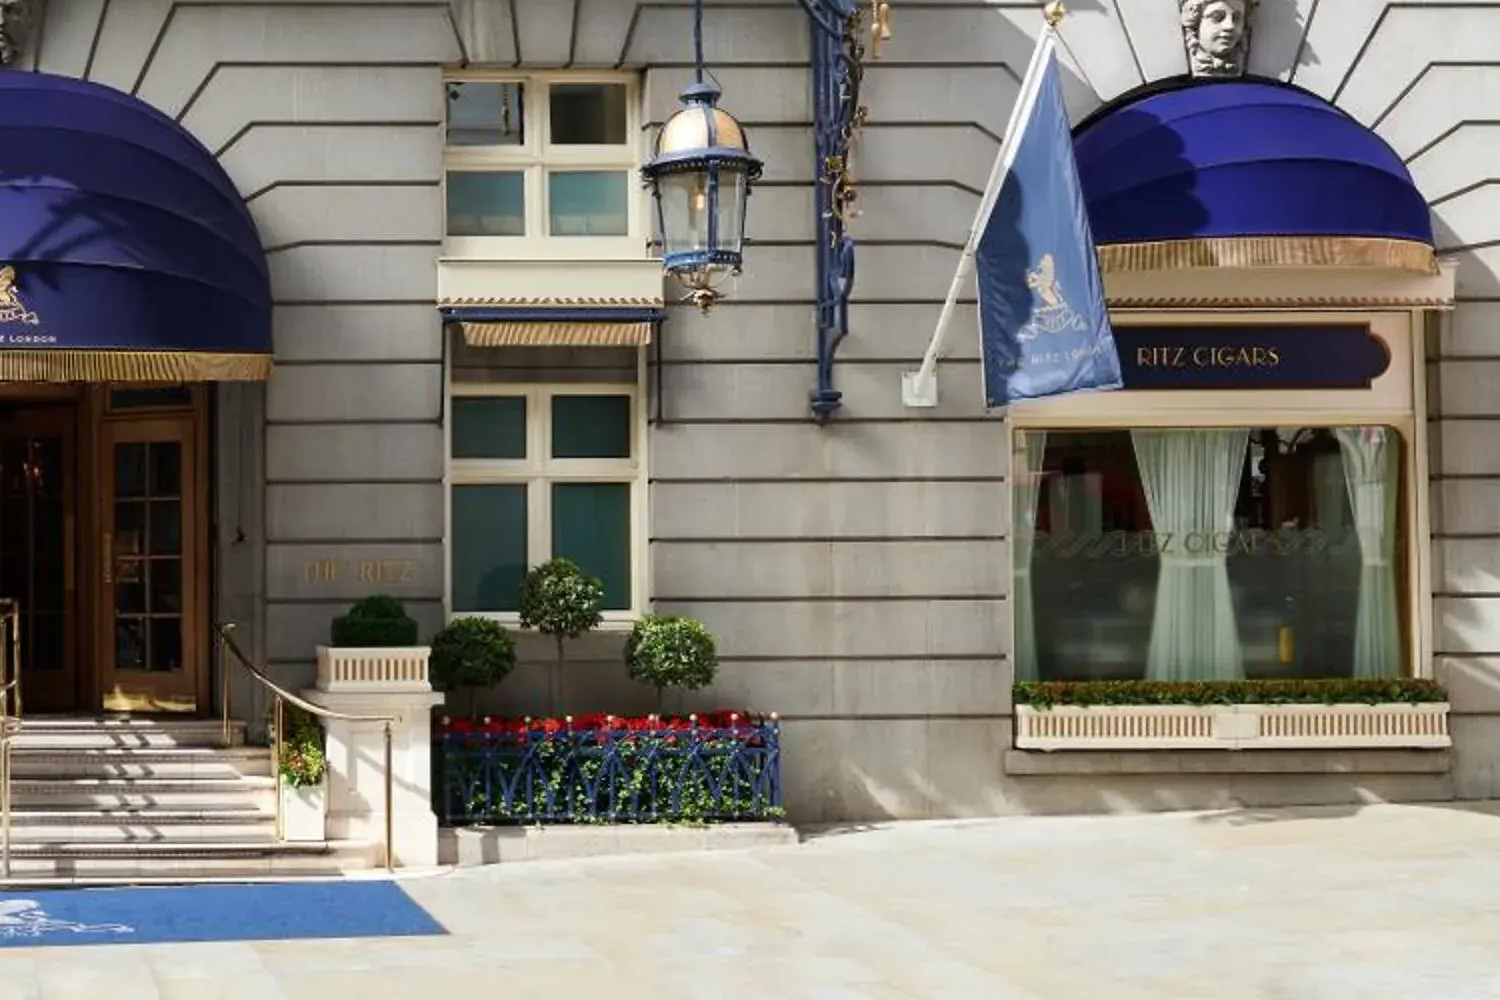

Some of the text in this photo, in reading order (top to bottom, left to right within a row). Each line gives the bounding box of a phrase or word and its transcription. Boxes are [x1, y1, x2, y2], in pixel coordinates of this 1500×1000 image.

[9, 335, 57, 343] LONDON
[1137, 346, 1280, 367] RITZ CIGARS
